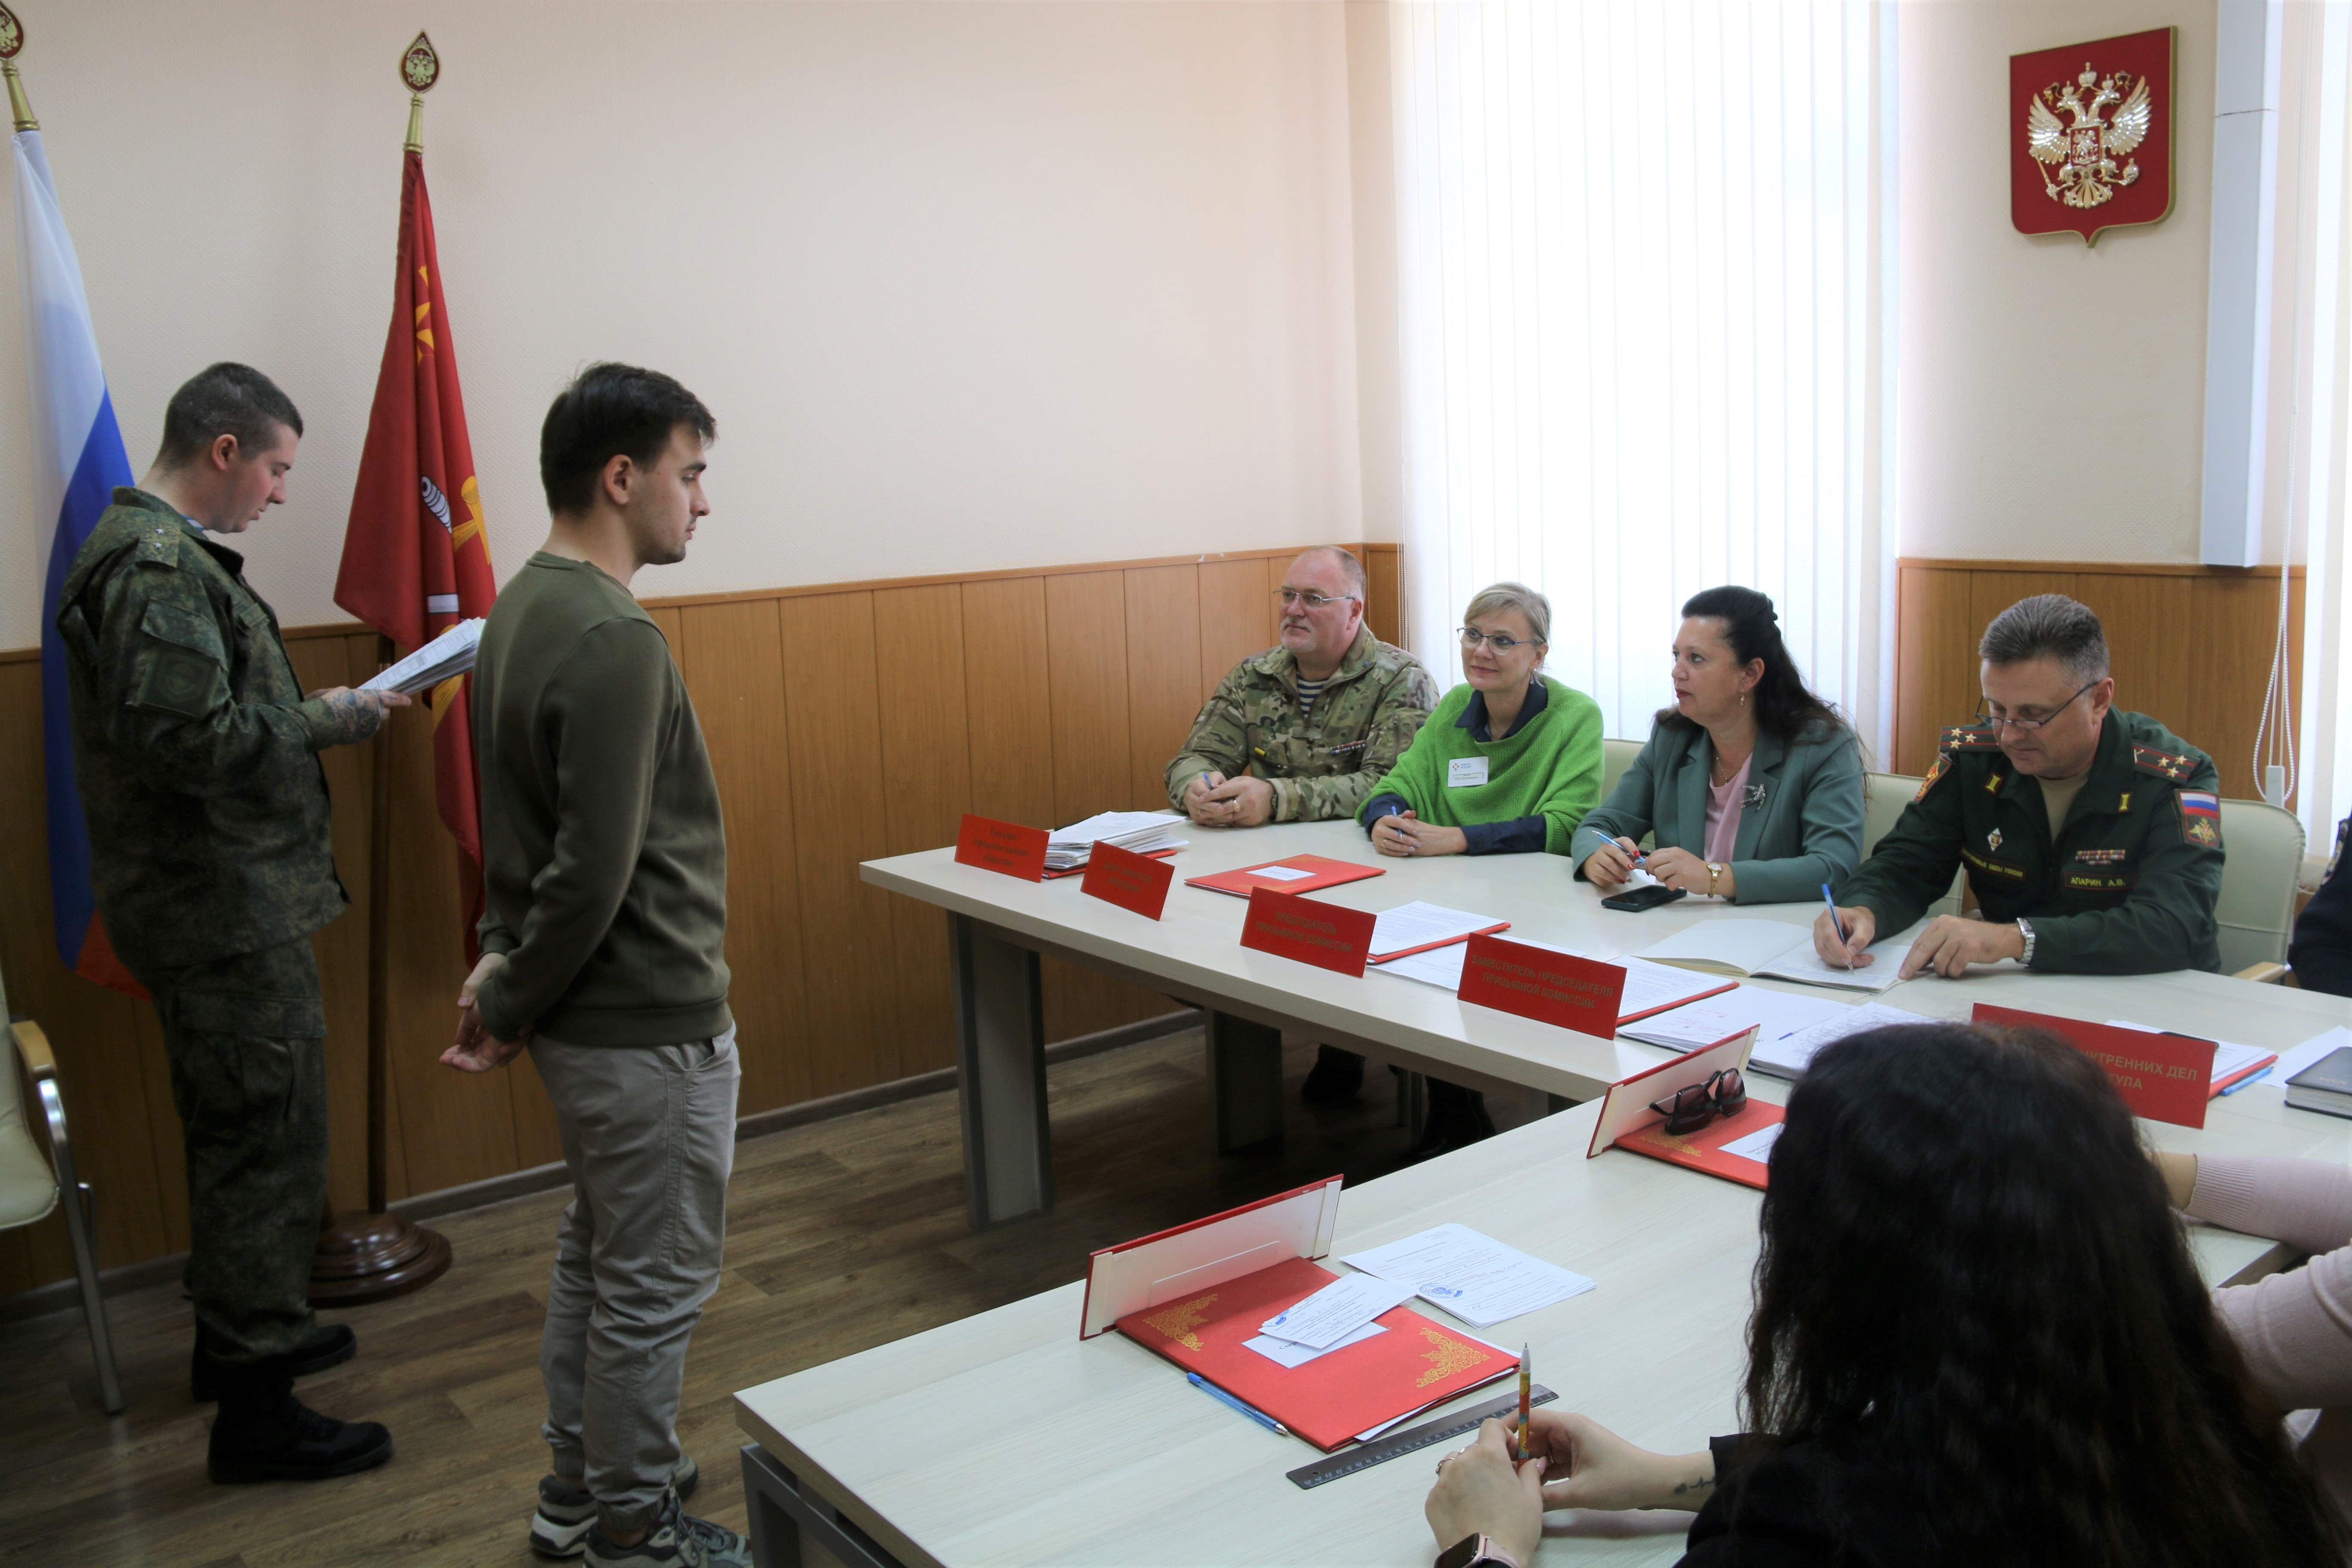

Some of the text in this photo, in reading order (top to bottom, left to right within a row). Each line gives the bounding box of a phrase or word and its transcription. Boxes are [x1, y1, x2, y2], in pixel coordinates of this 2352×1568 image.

[2070, 877, 2101, 887] АПАРИН
[1255, 922, 1353, 952] ПРИЗЫВНОЙ КОМИССИИ
[1275, 911, 1337, 934] ПРЕДСЕДАТЕЛЬ
[1472, 955, 1536, 978] ЗАМЕСТИТЕЛЬ
[1538, 971, 1614, 996] ПРЕДСЕДАТЕЛЯ
[1483, 973, 1595, 1008] ПРИЗЫВНОЙ КОМИССИИ
[2083, 1050, 2197, 1081] УТРЕННИХ ДЕЛ
